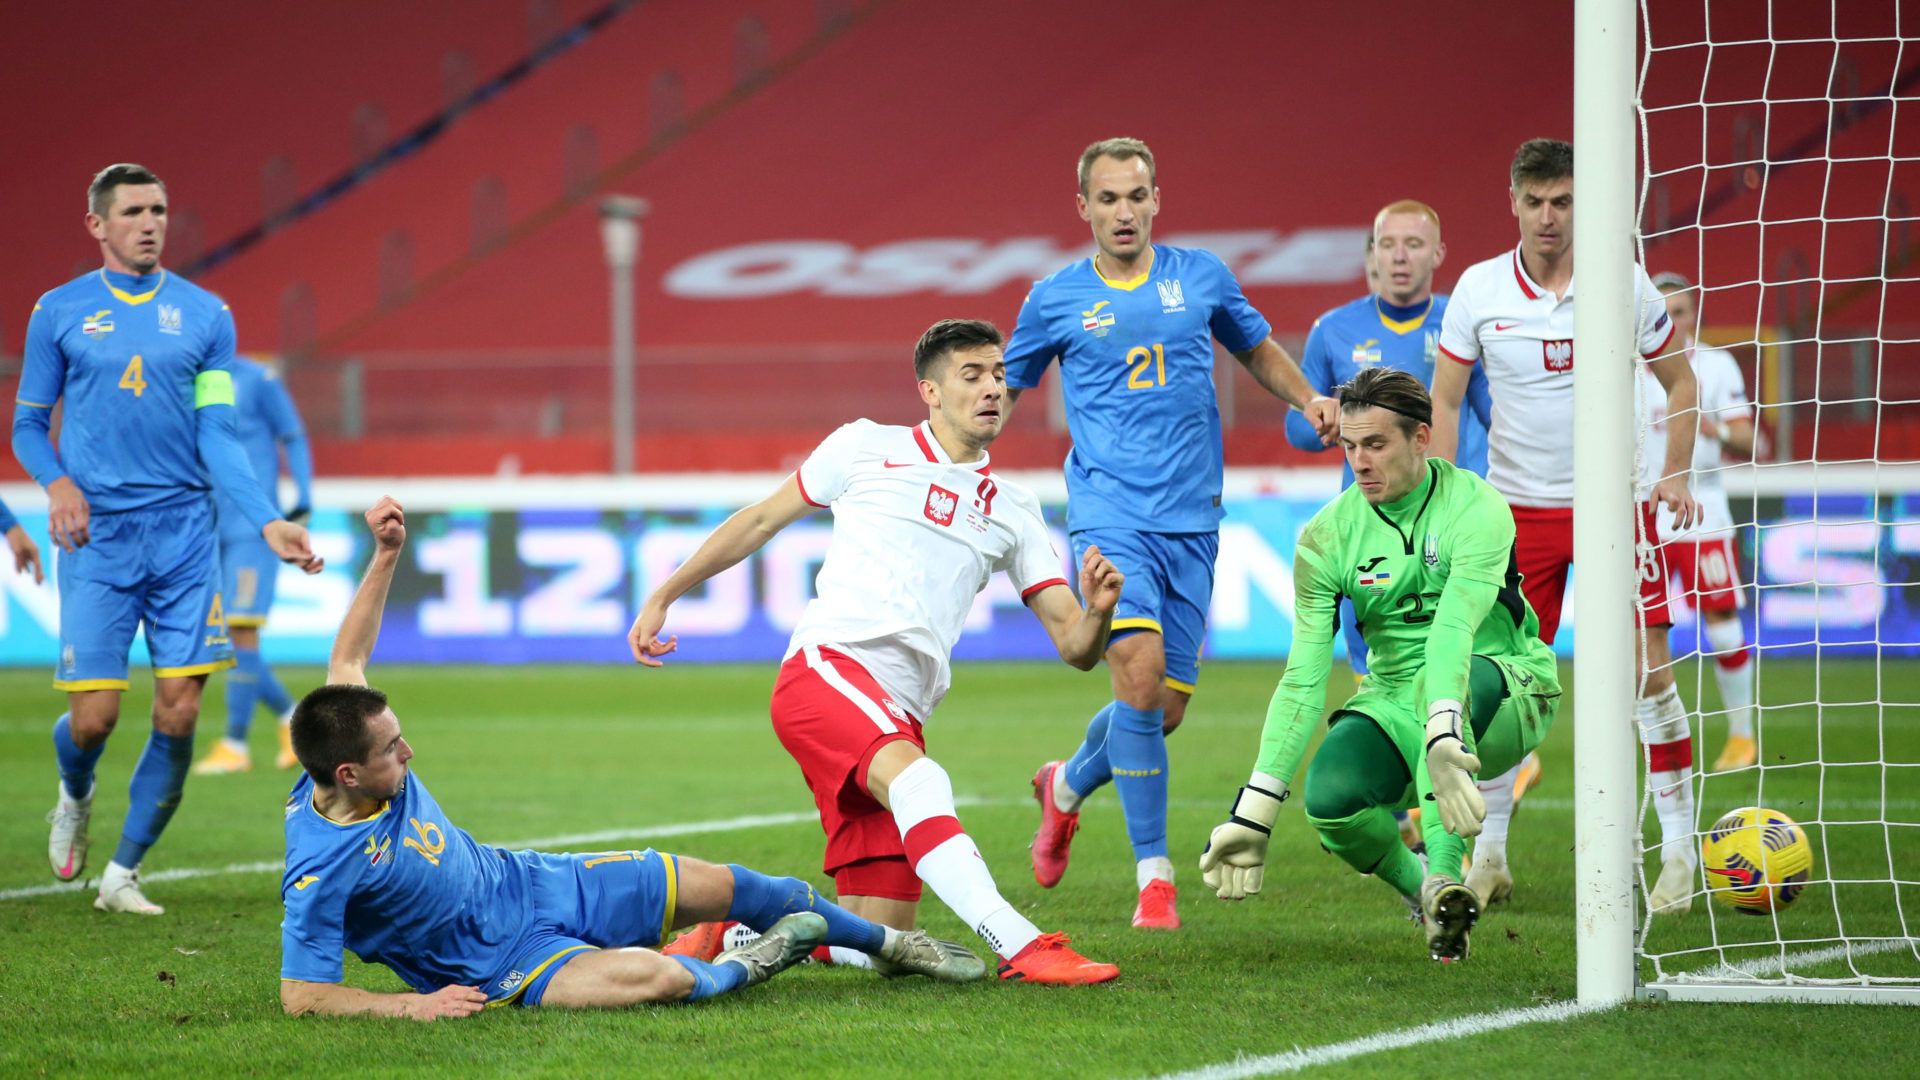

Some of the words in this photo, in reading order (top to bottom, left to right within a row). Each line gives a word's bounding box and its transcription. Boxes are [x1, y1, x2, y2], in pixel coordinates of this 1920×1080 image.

[664, 228, 1374, 297] OSHE
[117, 354, 148, 398] 4
[1125, 343, 1167, 390] 21
[974, 477, 999, 516] 9
[1700, 548, 1729, 590] 10
[206, 591, 225, 635] 4
[403, 817, 445, 867] 16
